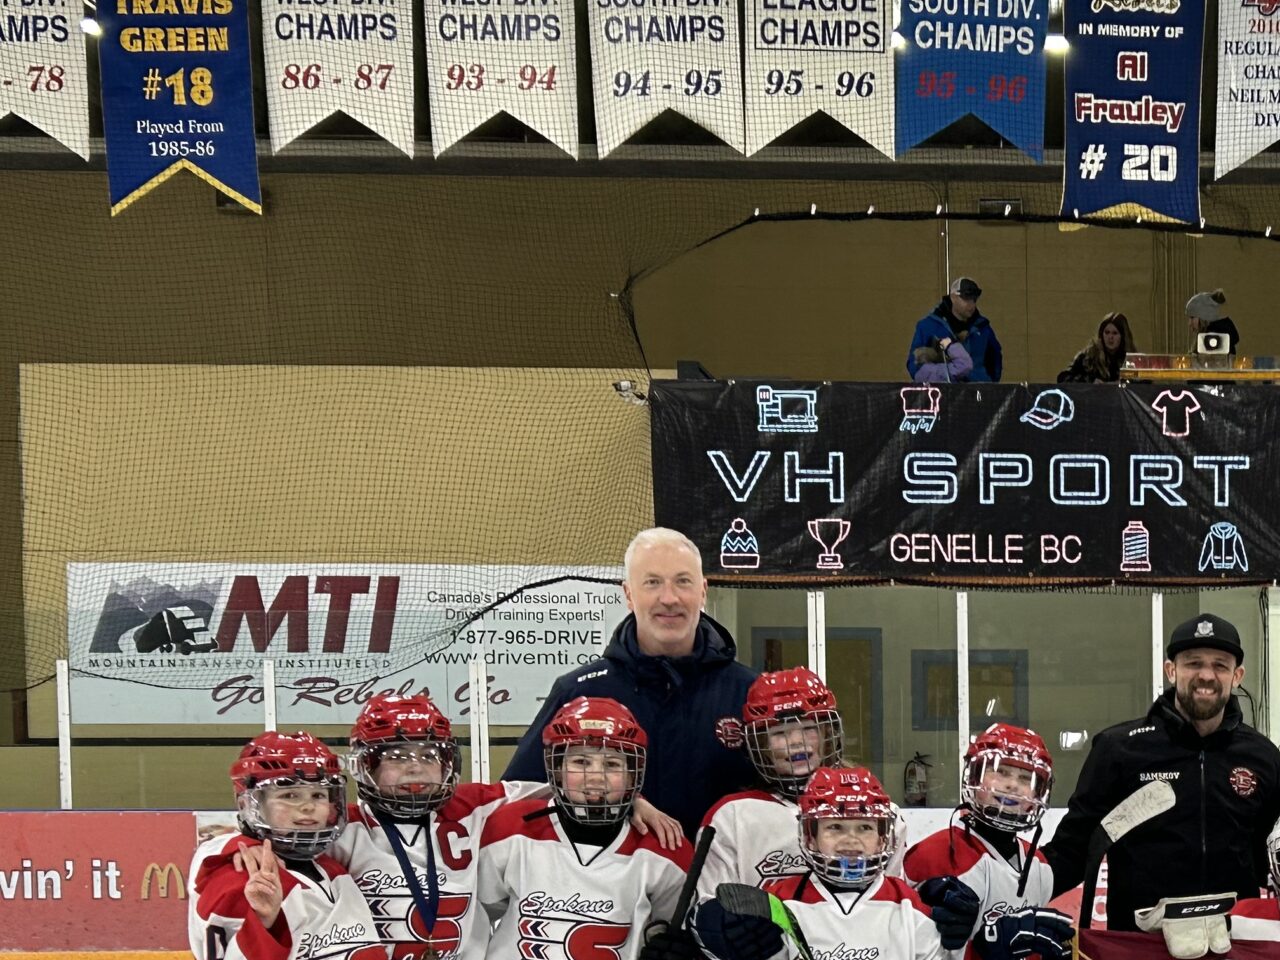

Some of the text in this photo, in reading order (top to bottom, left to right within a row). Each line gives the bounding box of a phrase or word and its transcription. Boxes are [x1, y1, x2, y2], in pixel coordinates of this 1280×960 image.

[119, 27, 229, 52] GREEN
[275, 13, 398, 41] CHAMPS
[438, 13, 561, 42] CHAMPS
[604, 14, 726, 44] CHAMPS
[760, 18, 881, 48] CHAMPS
[915, 20, 1034, 55] CHAMPS
[1079, 23, 1184, 38] IN MEMORY OF
[28, 65, 65, 92] 78
[142, 67, 214, 106] #18
[281, 63, 394, 90] 86 87
[446, 63, 557, 91] 93 94
[613, 69, 723, 97] 94 95
[765, 69, 875, 98] 95 96
[985, 75, 1027, 103] 96
[1228, 88, 1265, 105] NEIL
[1075, 93, 1185, 133] Frauley
[136, 120, 224, 138] Played From
[148, 141, 215, 157] 1985-86
[1079, 144, 1177, 182] # 20
[707, 450, 1250, 507] VH SPORT
[889, 533, 1083, 565] GENELLE BC
[427, 591, 491, 605] Canada's
[584, 592, 621, 605] Truck
[215, 575, 400, 653] MTI
[492, 608, 544, 623] Training
[549, 609, 604, 623] Experts!
[450, 630, 602, 645] 1-877-965-DRIVE
[212, 675, 265, 714] Go
[436, 822, 472, 870] C
[91, 860, 122, 899] it
[521, 891, 614, 915] Spokane
[1181, 904, 1221, 914] CCM
